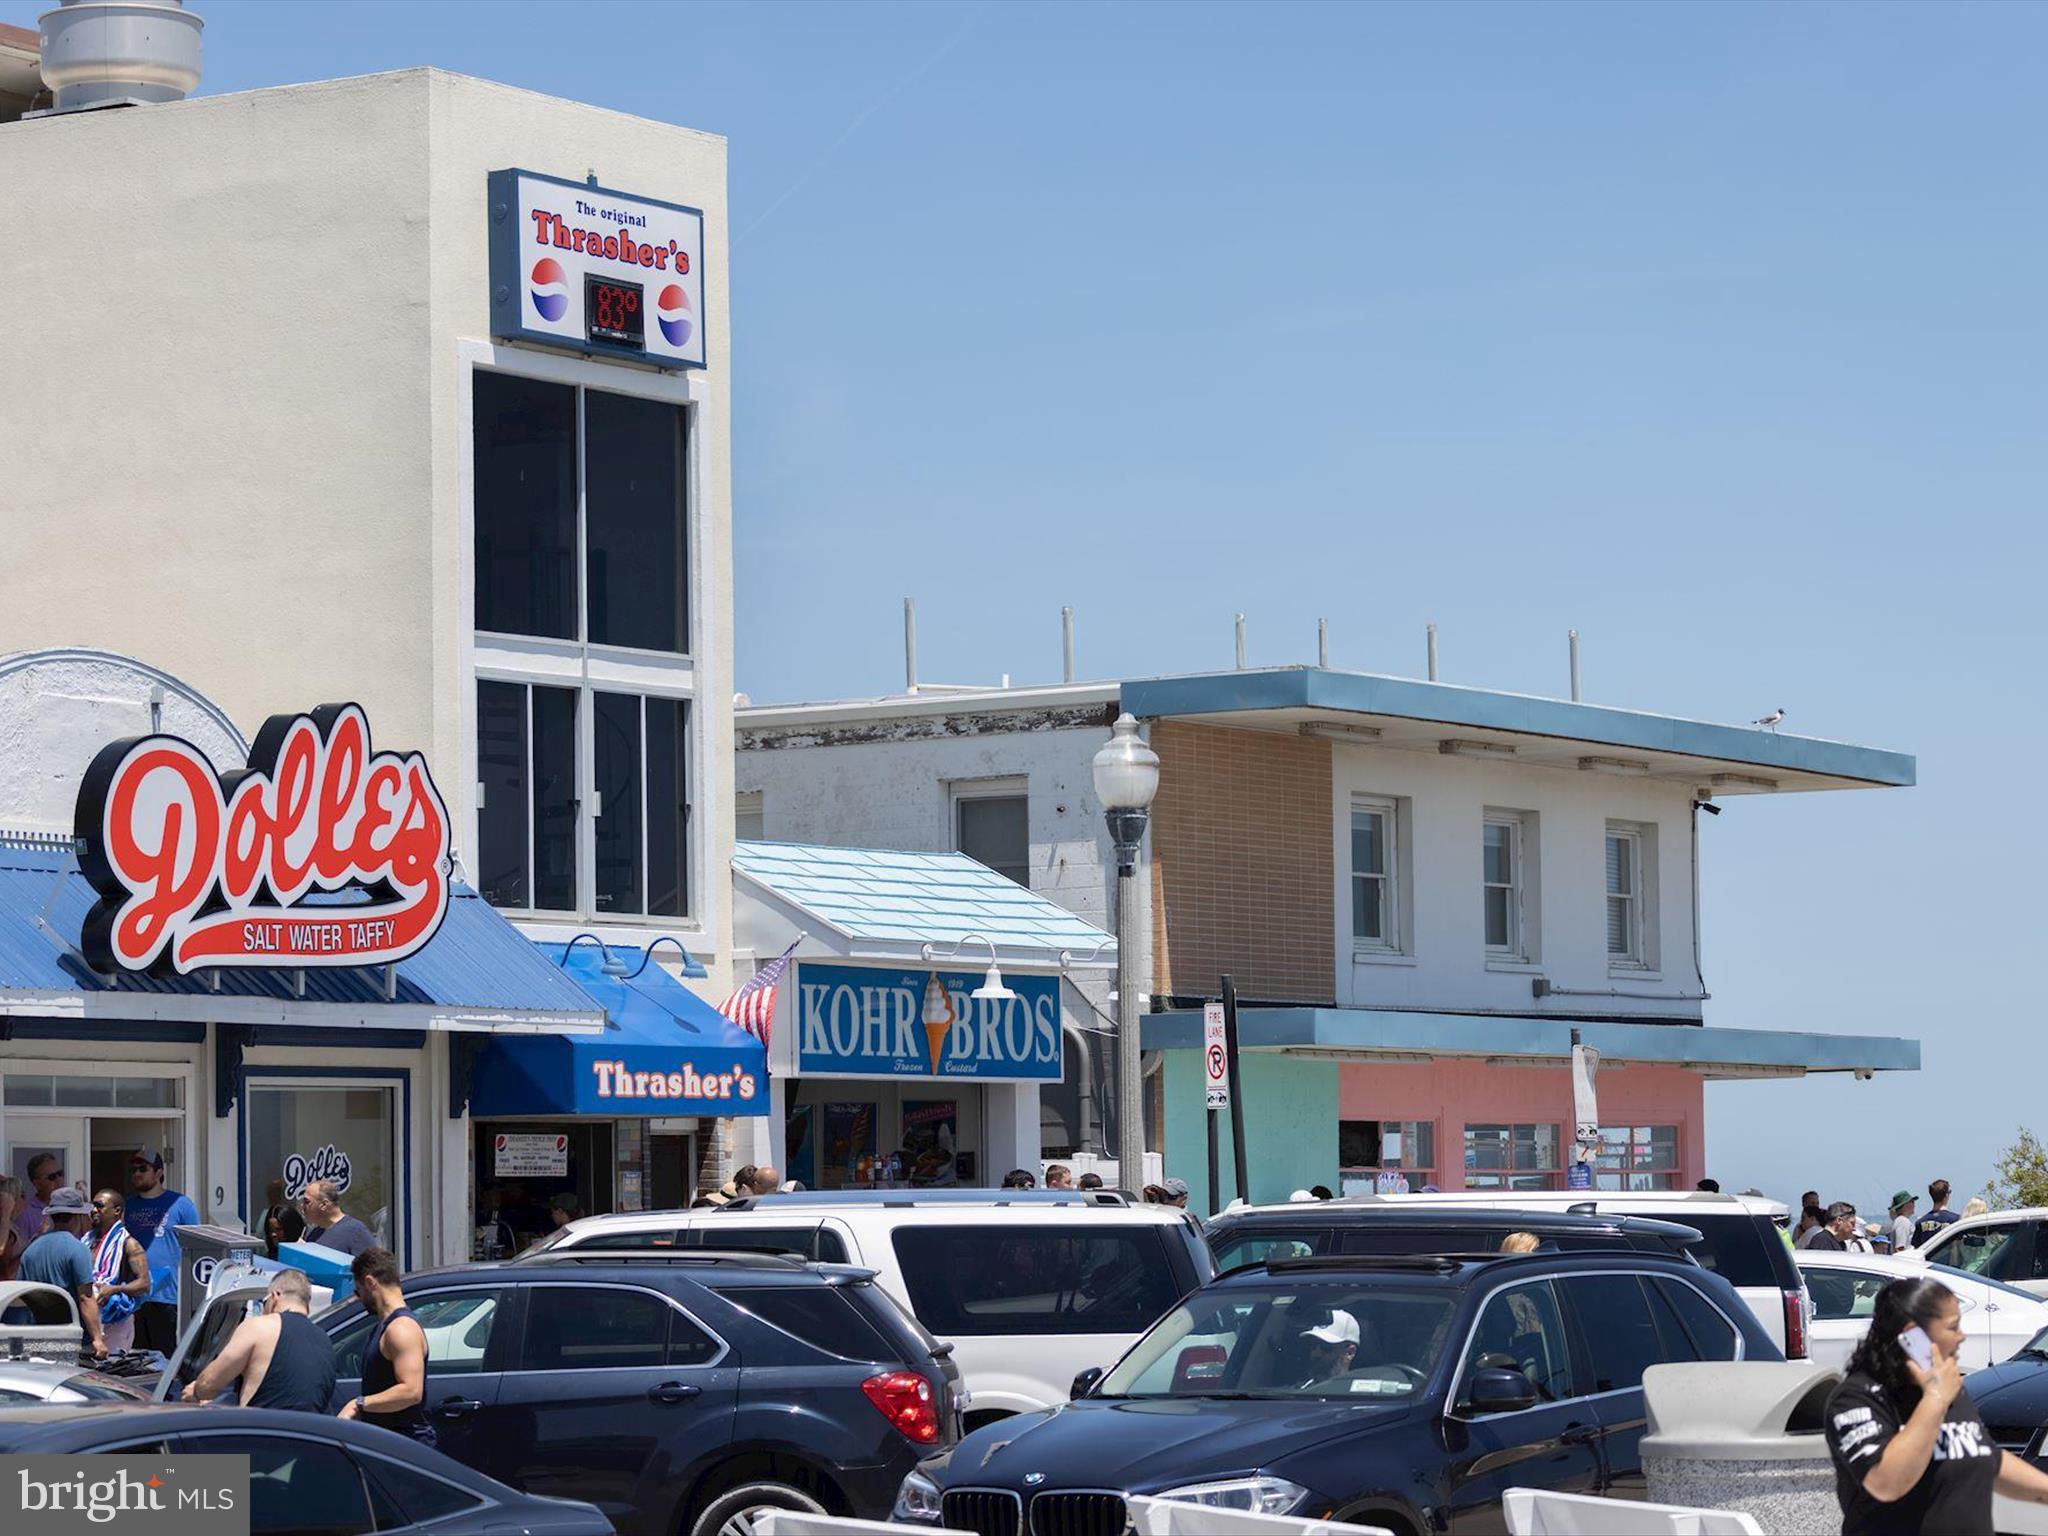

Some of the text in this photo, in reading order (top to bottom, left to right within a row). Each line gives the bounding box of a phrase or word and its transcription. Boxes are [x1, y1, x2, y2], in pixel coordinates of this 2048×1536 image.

[575, 200, 647, 229] The original
[531, 208, 690, 275] Thrasher's
[243, 919, 396, 952] SALT WATER TAFFY
[800, 984, 920, 1058] KOHR
[1208, 1011, 1222, 1024] FIRE
[1208, 1026, 1223, 1039] LANE
[593, 1060, 756, 1100] Thrasher's
[893, 1058, 978, 1074] Frozen Custard
[215, 1185, 225, 1207] 9
